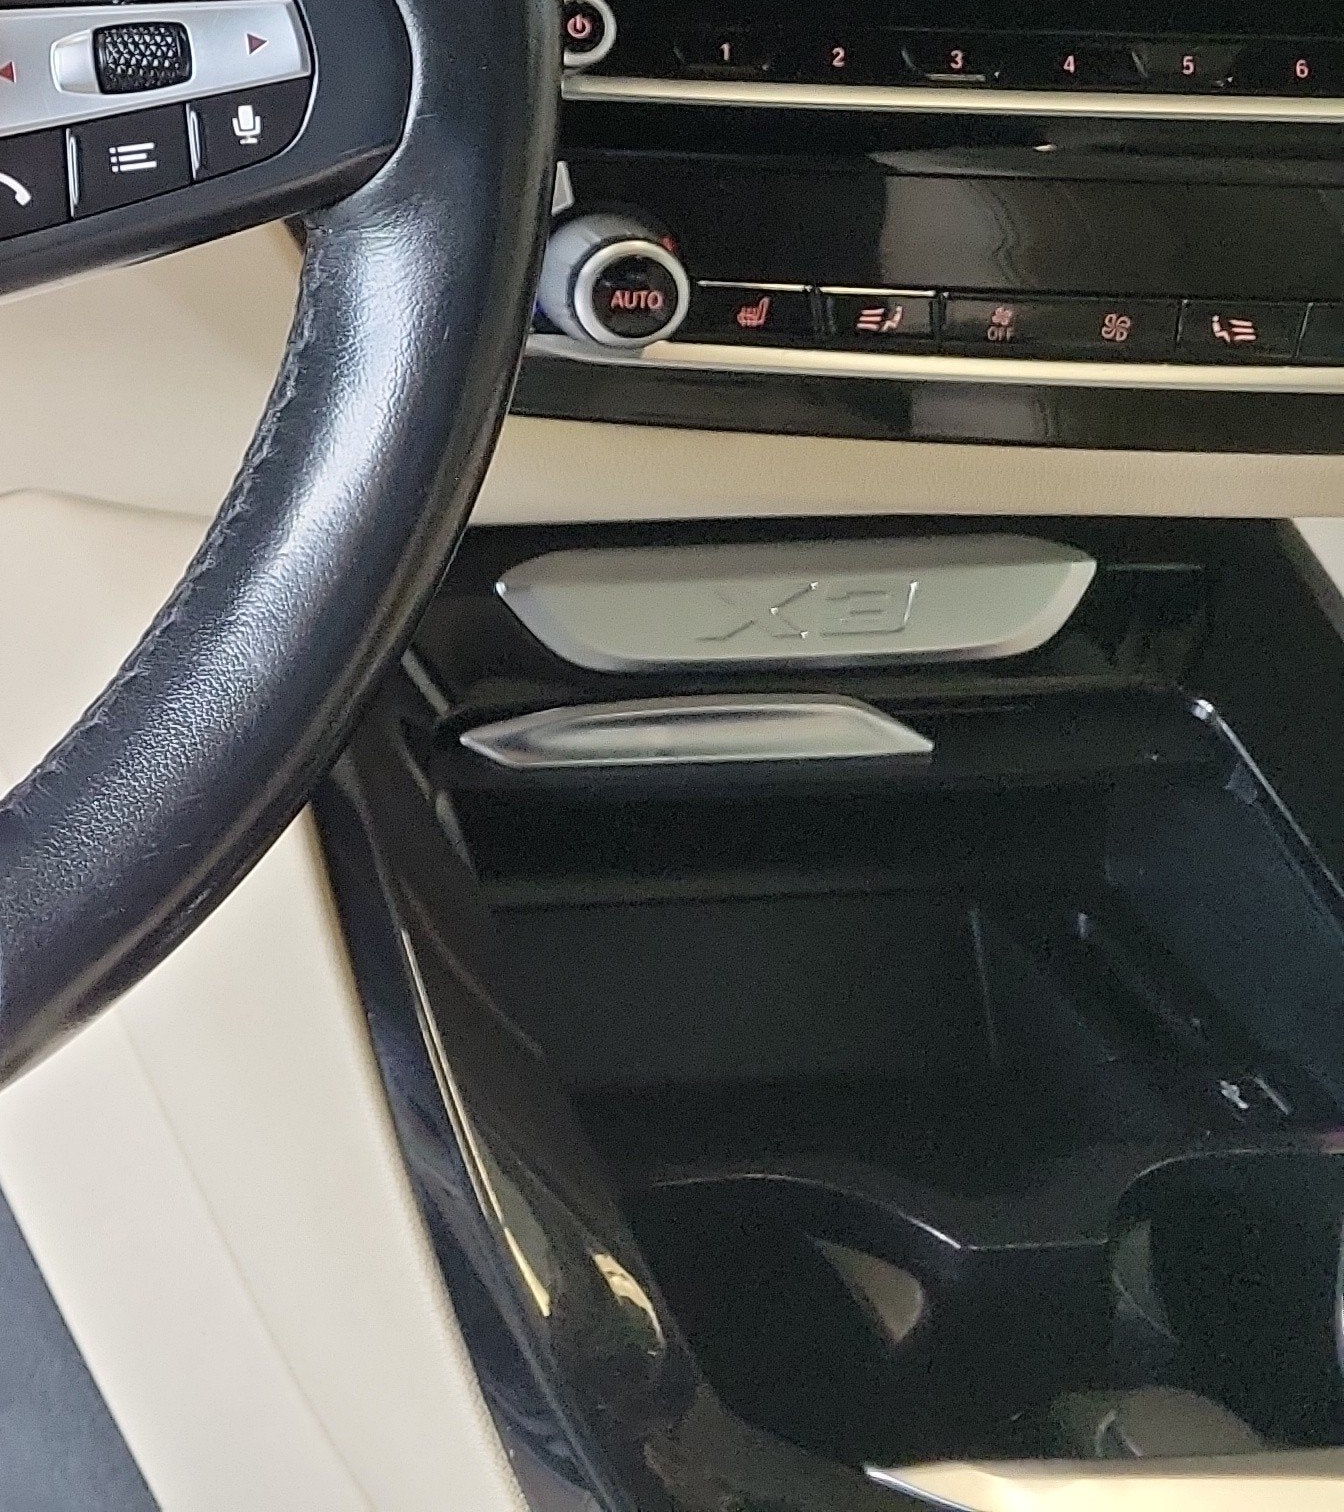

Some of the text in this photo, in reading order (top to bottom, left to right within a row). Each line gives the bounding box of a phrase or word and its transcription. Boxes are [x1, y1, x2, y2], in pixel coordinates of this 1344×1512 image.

[718, 42, 1310, 80] 1 2 3 4 5 6
[610, 290, 664, 311] AUTO
